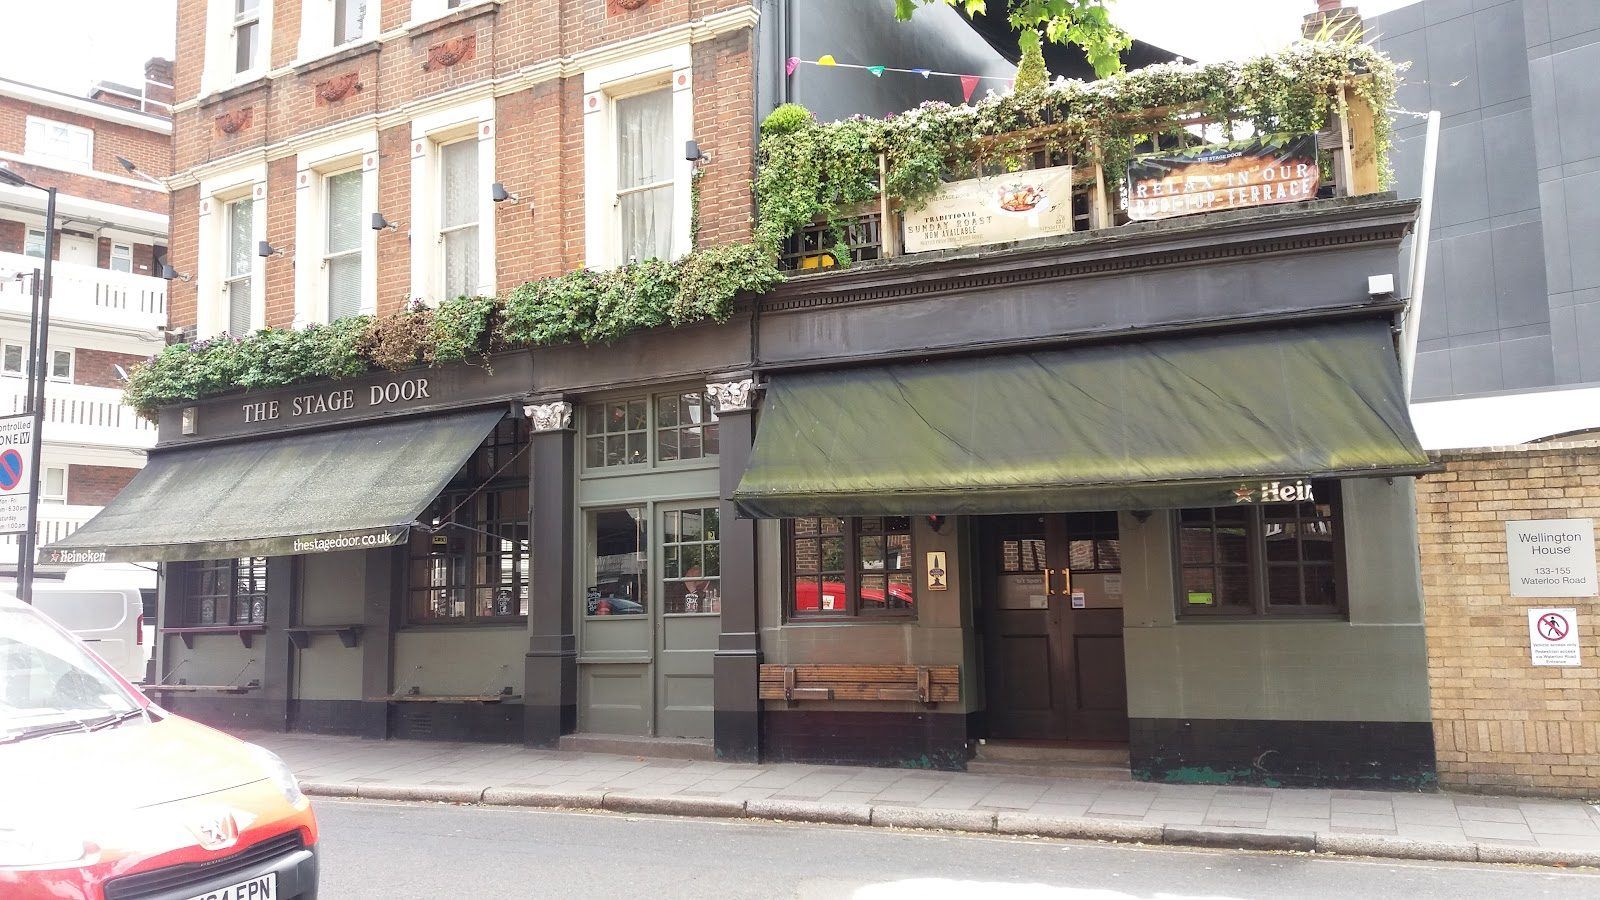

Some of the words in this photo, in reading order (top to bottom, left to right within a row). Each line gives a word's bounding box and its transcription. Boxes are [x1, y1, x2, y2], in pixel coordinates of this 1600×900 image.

[1136, 175, 1212, 199] RELAX
[1227, 170, 1249, 187] IN
[1263, 163, 1307, 182] OUR
[1228, 178, 1310, 207] TERRACE
[924, 211, 976, 223] TRADITIONAL
[908, 221, 949, 234] SUNDAY
[956, 215, 992, 228] ROAST
[924, 231, 939, 240] NOW
[941, 226, 977, 238] AVAILABLE
[242, 400, 280, 424] THE
[292, 389, 355, 417] STAGE
[369, 378, 430, 406] DOOR
[0, 420, 31, 432] ontrolled
[0, 433, 18, 446] ONE
[293, 529, 392, 552] thestagedoor.co.uk
[1518, 532, 1582, 545] Wellington
[60, 549, 106, 563] Heineken
[1531, 545, 1571, 555] House
[1535, 567, 1571, 575] 133-155
[1520, 577, 1560, 585] Waterloo
[1562, 576, 1586, 584] Road
